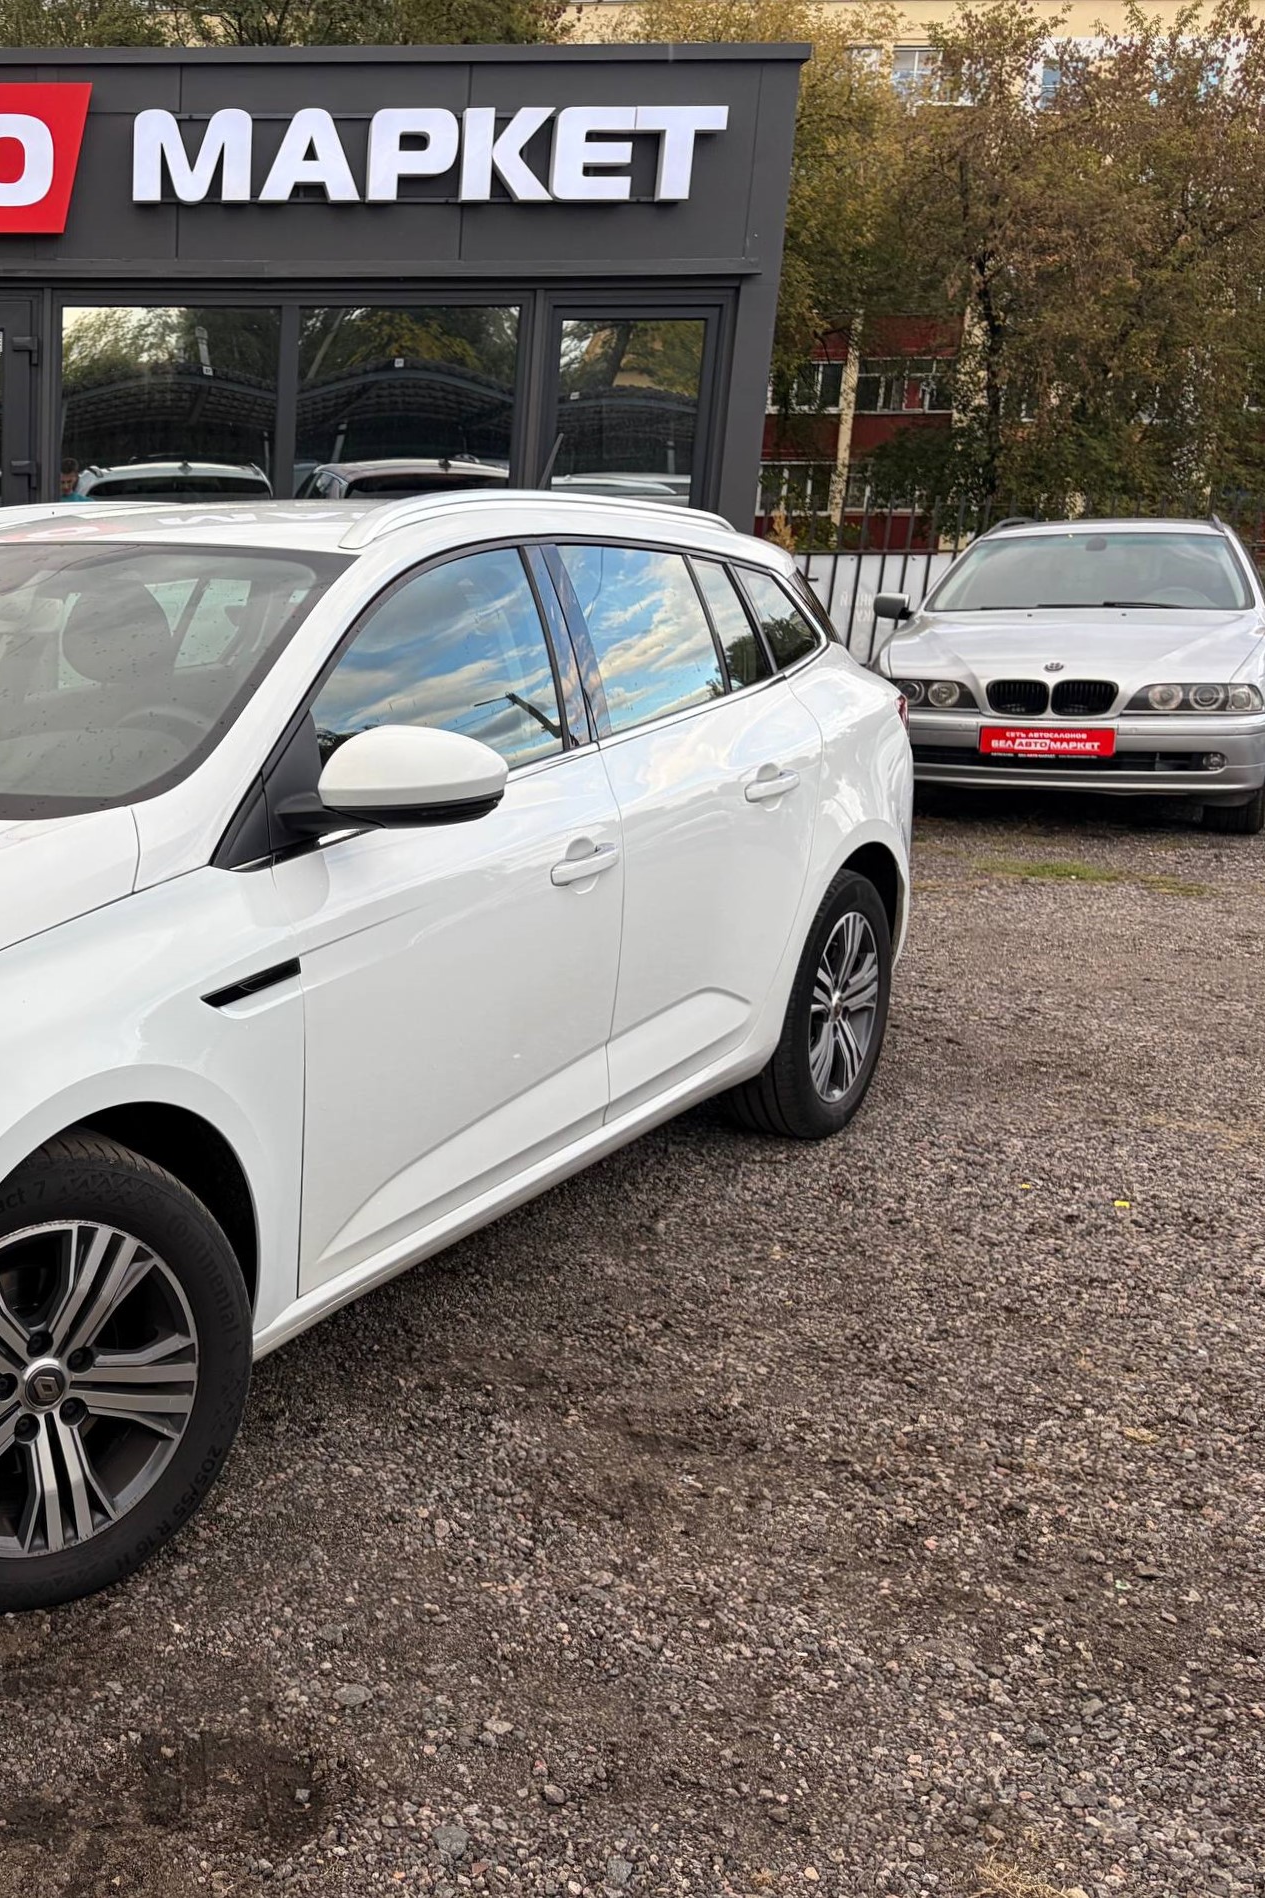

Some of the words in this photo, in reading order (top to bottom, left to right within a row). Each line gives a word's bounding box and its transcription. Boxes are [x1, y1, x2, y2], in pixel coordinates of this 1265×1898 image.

[132, 105, 729, 205] МАРКЕТ
[1028, 731, 1088, 739] АВТОСАЛОНОВ
[991, 739, 1014, 748] БЕЛ
[1016, 740, 1049, 750] АВТО
[1050, 741, 1100, 751] МАРКЕТ
